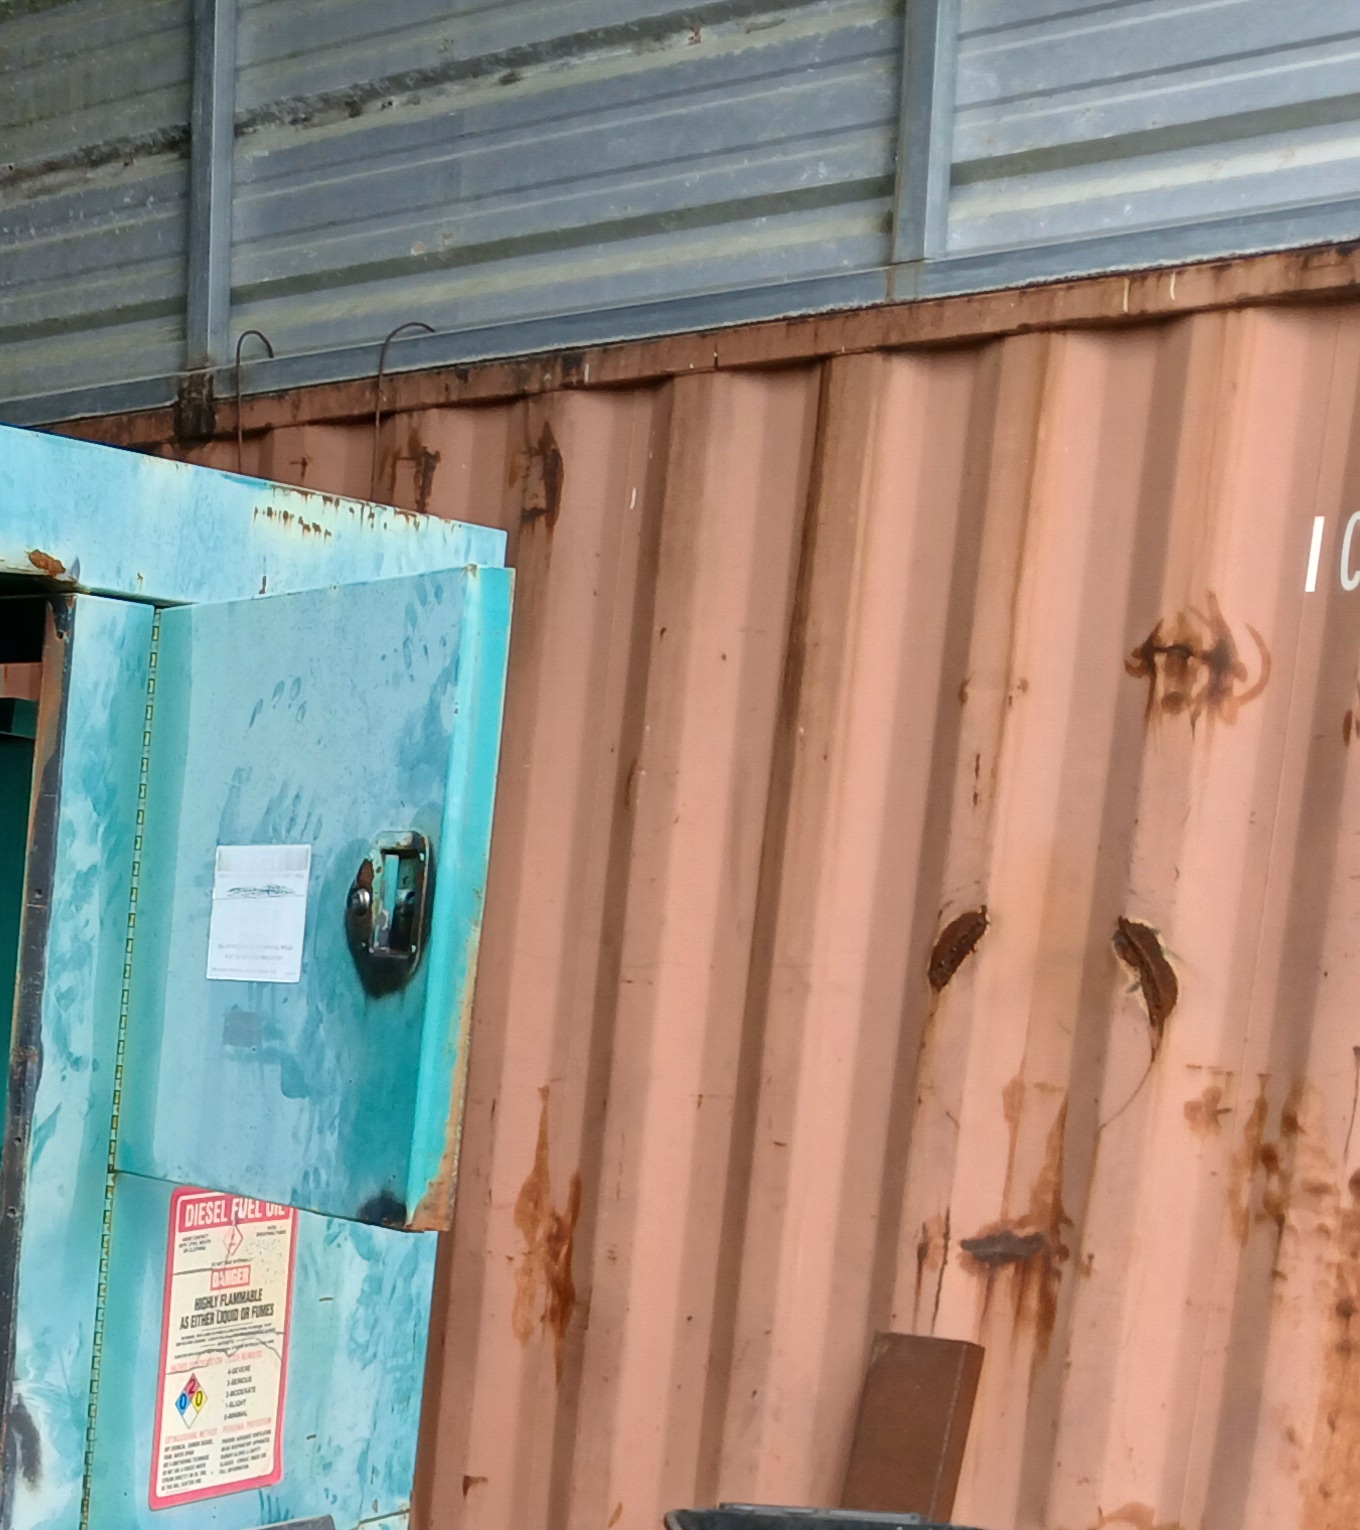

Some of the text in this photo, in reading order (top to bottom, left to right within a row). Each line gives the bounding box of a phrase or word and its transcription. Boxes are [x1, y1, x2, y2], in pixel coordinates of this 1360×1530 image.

[184, 1199, 229, 1228] DIESEL
[230, 1197, 263, 1221] FUEL
[212, 1266, 250, 1288] DANGER
[194, 1288, 263, 1311] HIGHLY FLAMMABLE
[179, 1303, 275, 1330] AS EITHER LIQUID OR FUMES
[188, 1377, 196, 1395] 2
[179, 1392, 187, 1410] 0
[195, 1390, 203, 1407] 0
